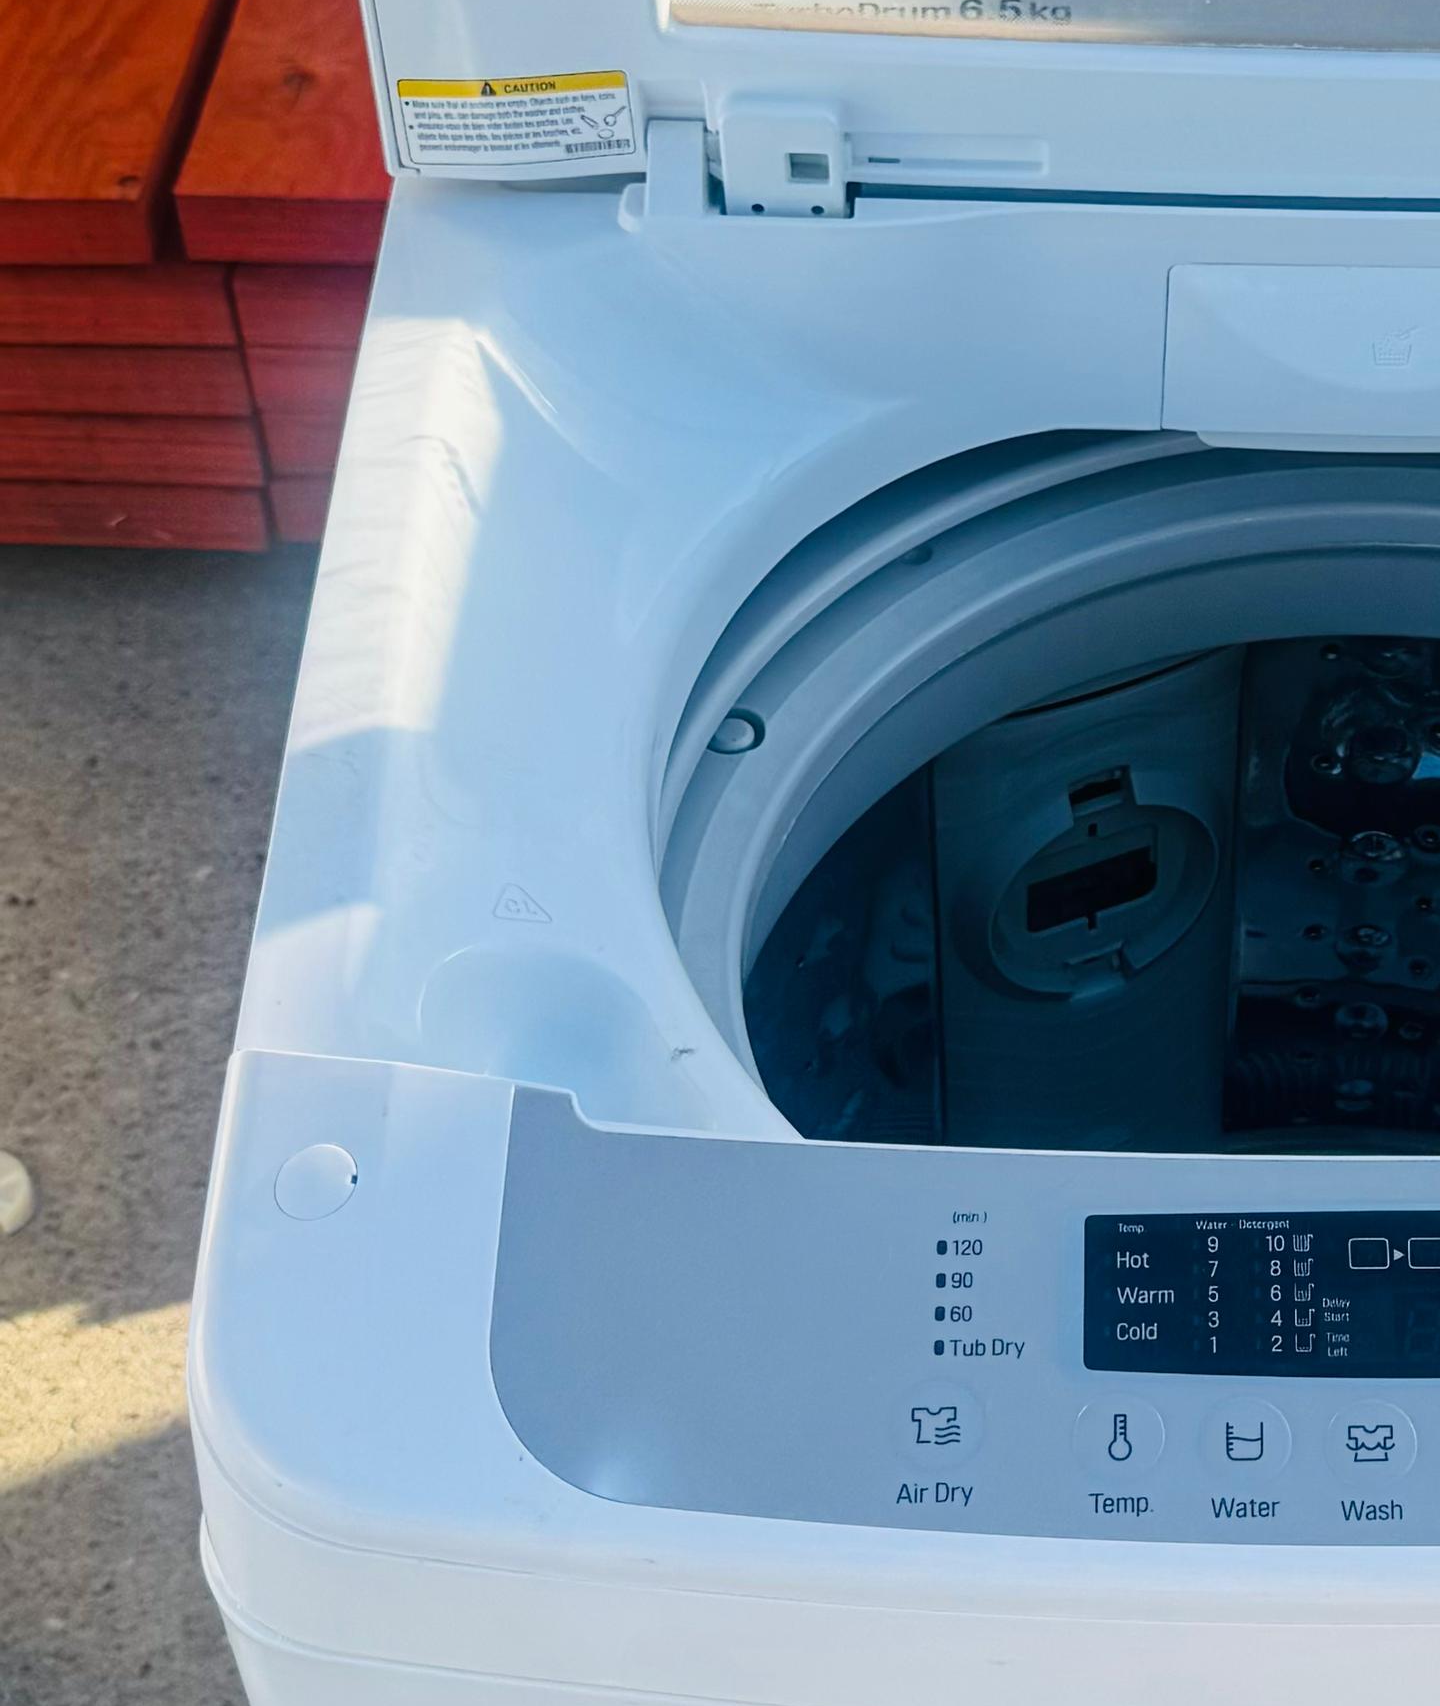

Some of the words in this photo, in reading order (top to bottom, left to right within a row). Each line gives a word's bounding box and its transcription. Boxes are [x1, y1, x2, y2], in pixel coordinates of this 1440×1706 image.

[504, 81, 556, 94] CAUTION
[1195, 1219, 1228, 1230] Water
[1239, 1219, 1290, 1231] Detergent
[952, 1239, 984, 1256] 120
[1207, 1236, 1219, 1253] 9
[1266, 1235, 1285, 1252] 10
[1116, 1251, 1150, 1269] Hot
[1208, 1260, 1219, 1278] 7
[1270, 1260, 1281, 1277] 8
[951, 1272, 974, 1289] 90
[1117, 1287, 1175, 1305] Warm
[1208, 1285, 1219, 1303] 5
[1270, 1285, 1282, 1302] 6
[950, 1305, 973, 1323] 60
[1208, 1310, 1220, 1328] 3
[1270, 1309, 1283, 1327] 4
[1116, 1322, 1158, 1341] Cold
[949, 1339, 986, 1357] Tub
[992, 1338, 1025, 1359] Dry
[1209, 1336, 1217, 1354] 1
[1271, 1335, 1283, 1353] 2
[896, 1483, 930, 1505] Air
[935, 1482, 973, 1507] Dry
[1089, 1493, 1154, 1518] Temp.
[1211, 1497, 1280, 1519] Water
[1341, 1499, 1404, 1521] Wash
